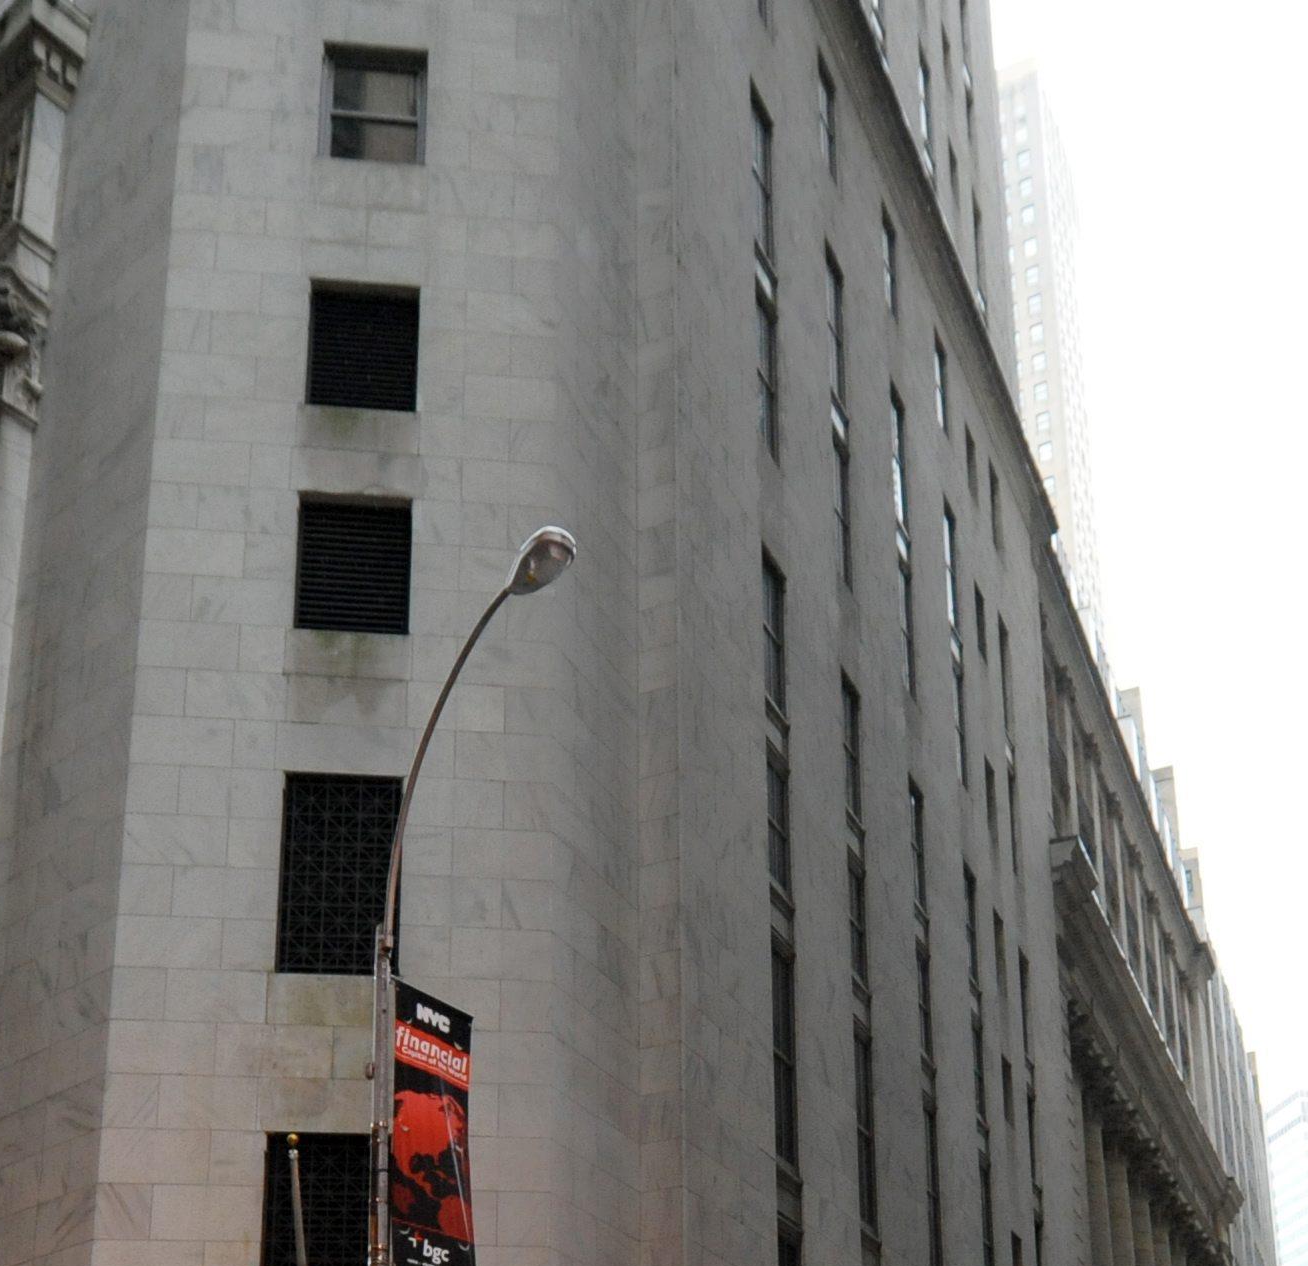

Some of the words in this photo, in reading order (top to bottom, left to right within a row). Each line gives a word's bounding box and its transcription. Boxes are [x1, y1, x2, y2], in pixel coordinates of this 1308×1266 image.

[416, 1002, 451, 1034] NYC
[396, 1026, 468, 1073] financial
[422, 1239, 450, 1265] bgc
